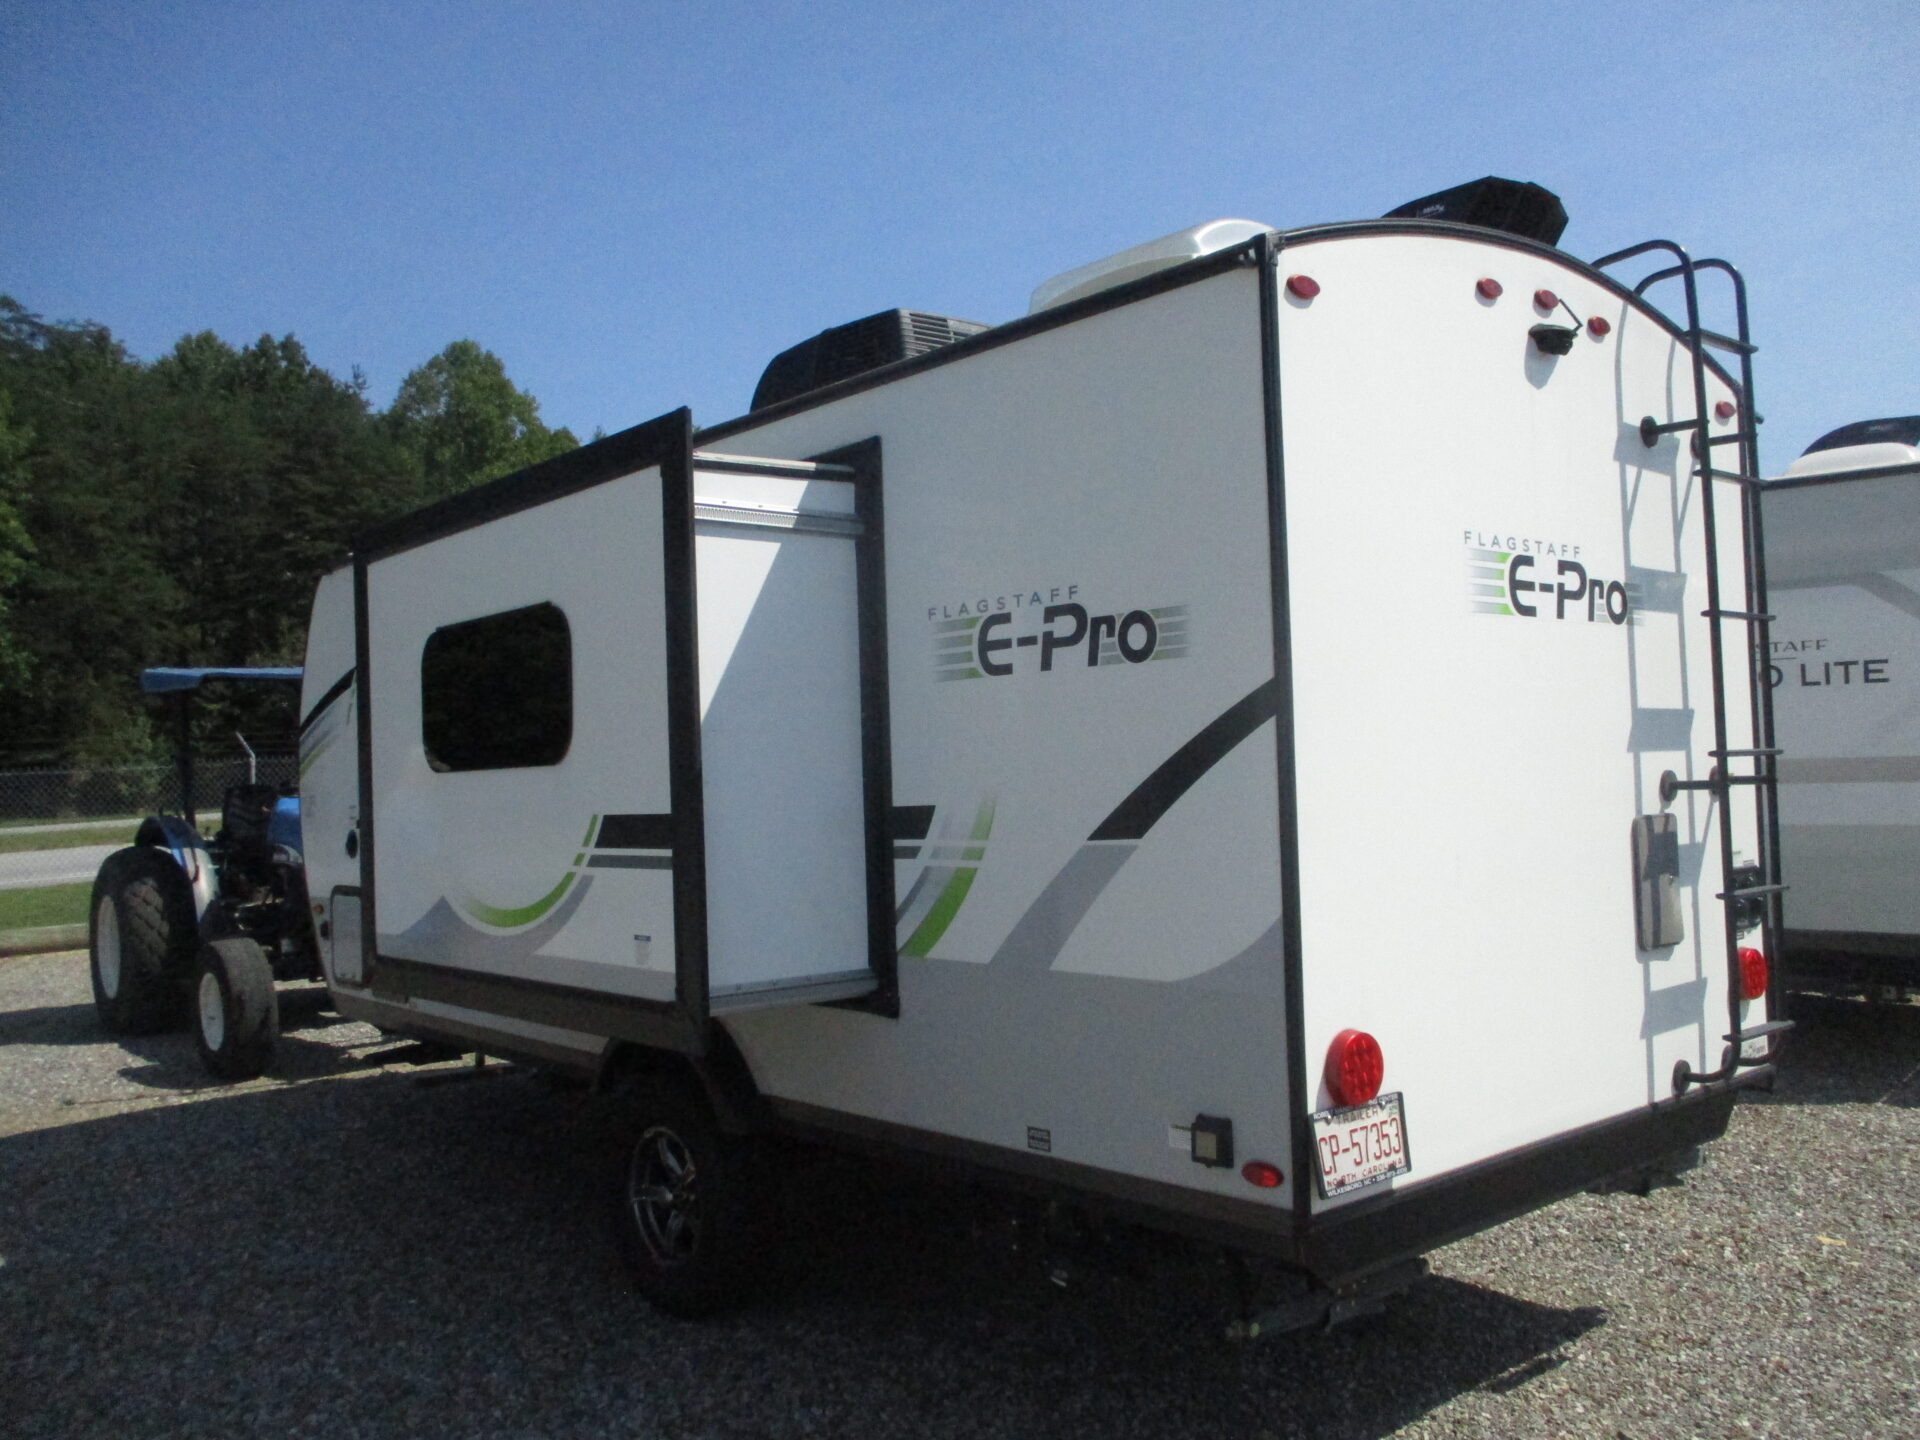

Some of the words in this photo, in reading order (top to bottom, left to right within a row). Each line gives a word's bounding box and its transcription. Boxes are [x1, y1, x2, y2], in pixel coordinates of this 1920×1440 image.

[1464, 530, 1580, 558] FLAGSTAFF
[928, 585, 1079, 621] FLAGSTAFF
[1508, 554, 1628, 625] E-Pro
[977, 602, 1158, 677] E-Pro
[1755, 638, 1829, 655] TAFF
[1800, 659, 1890, 687] LITE
[1318, 1117, 1401, 1175] CP-57353
